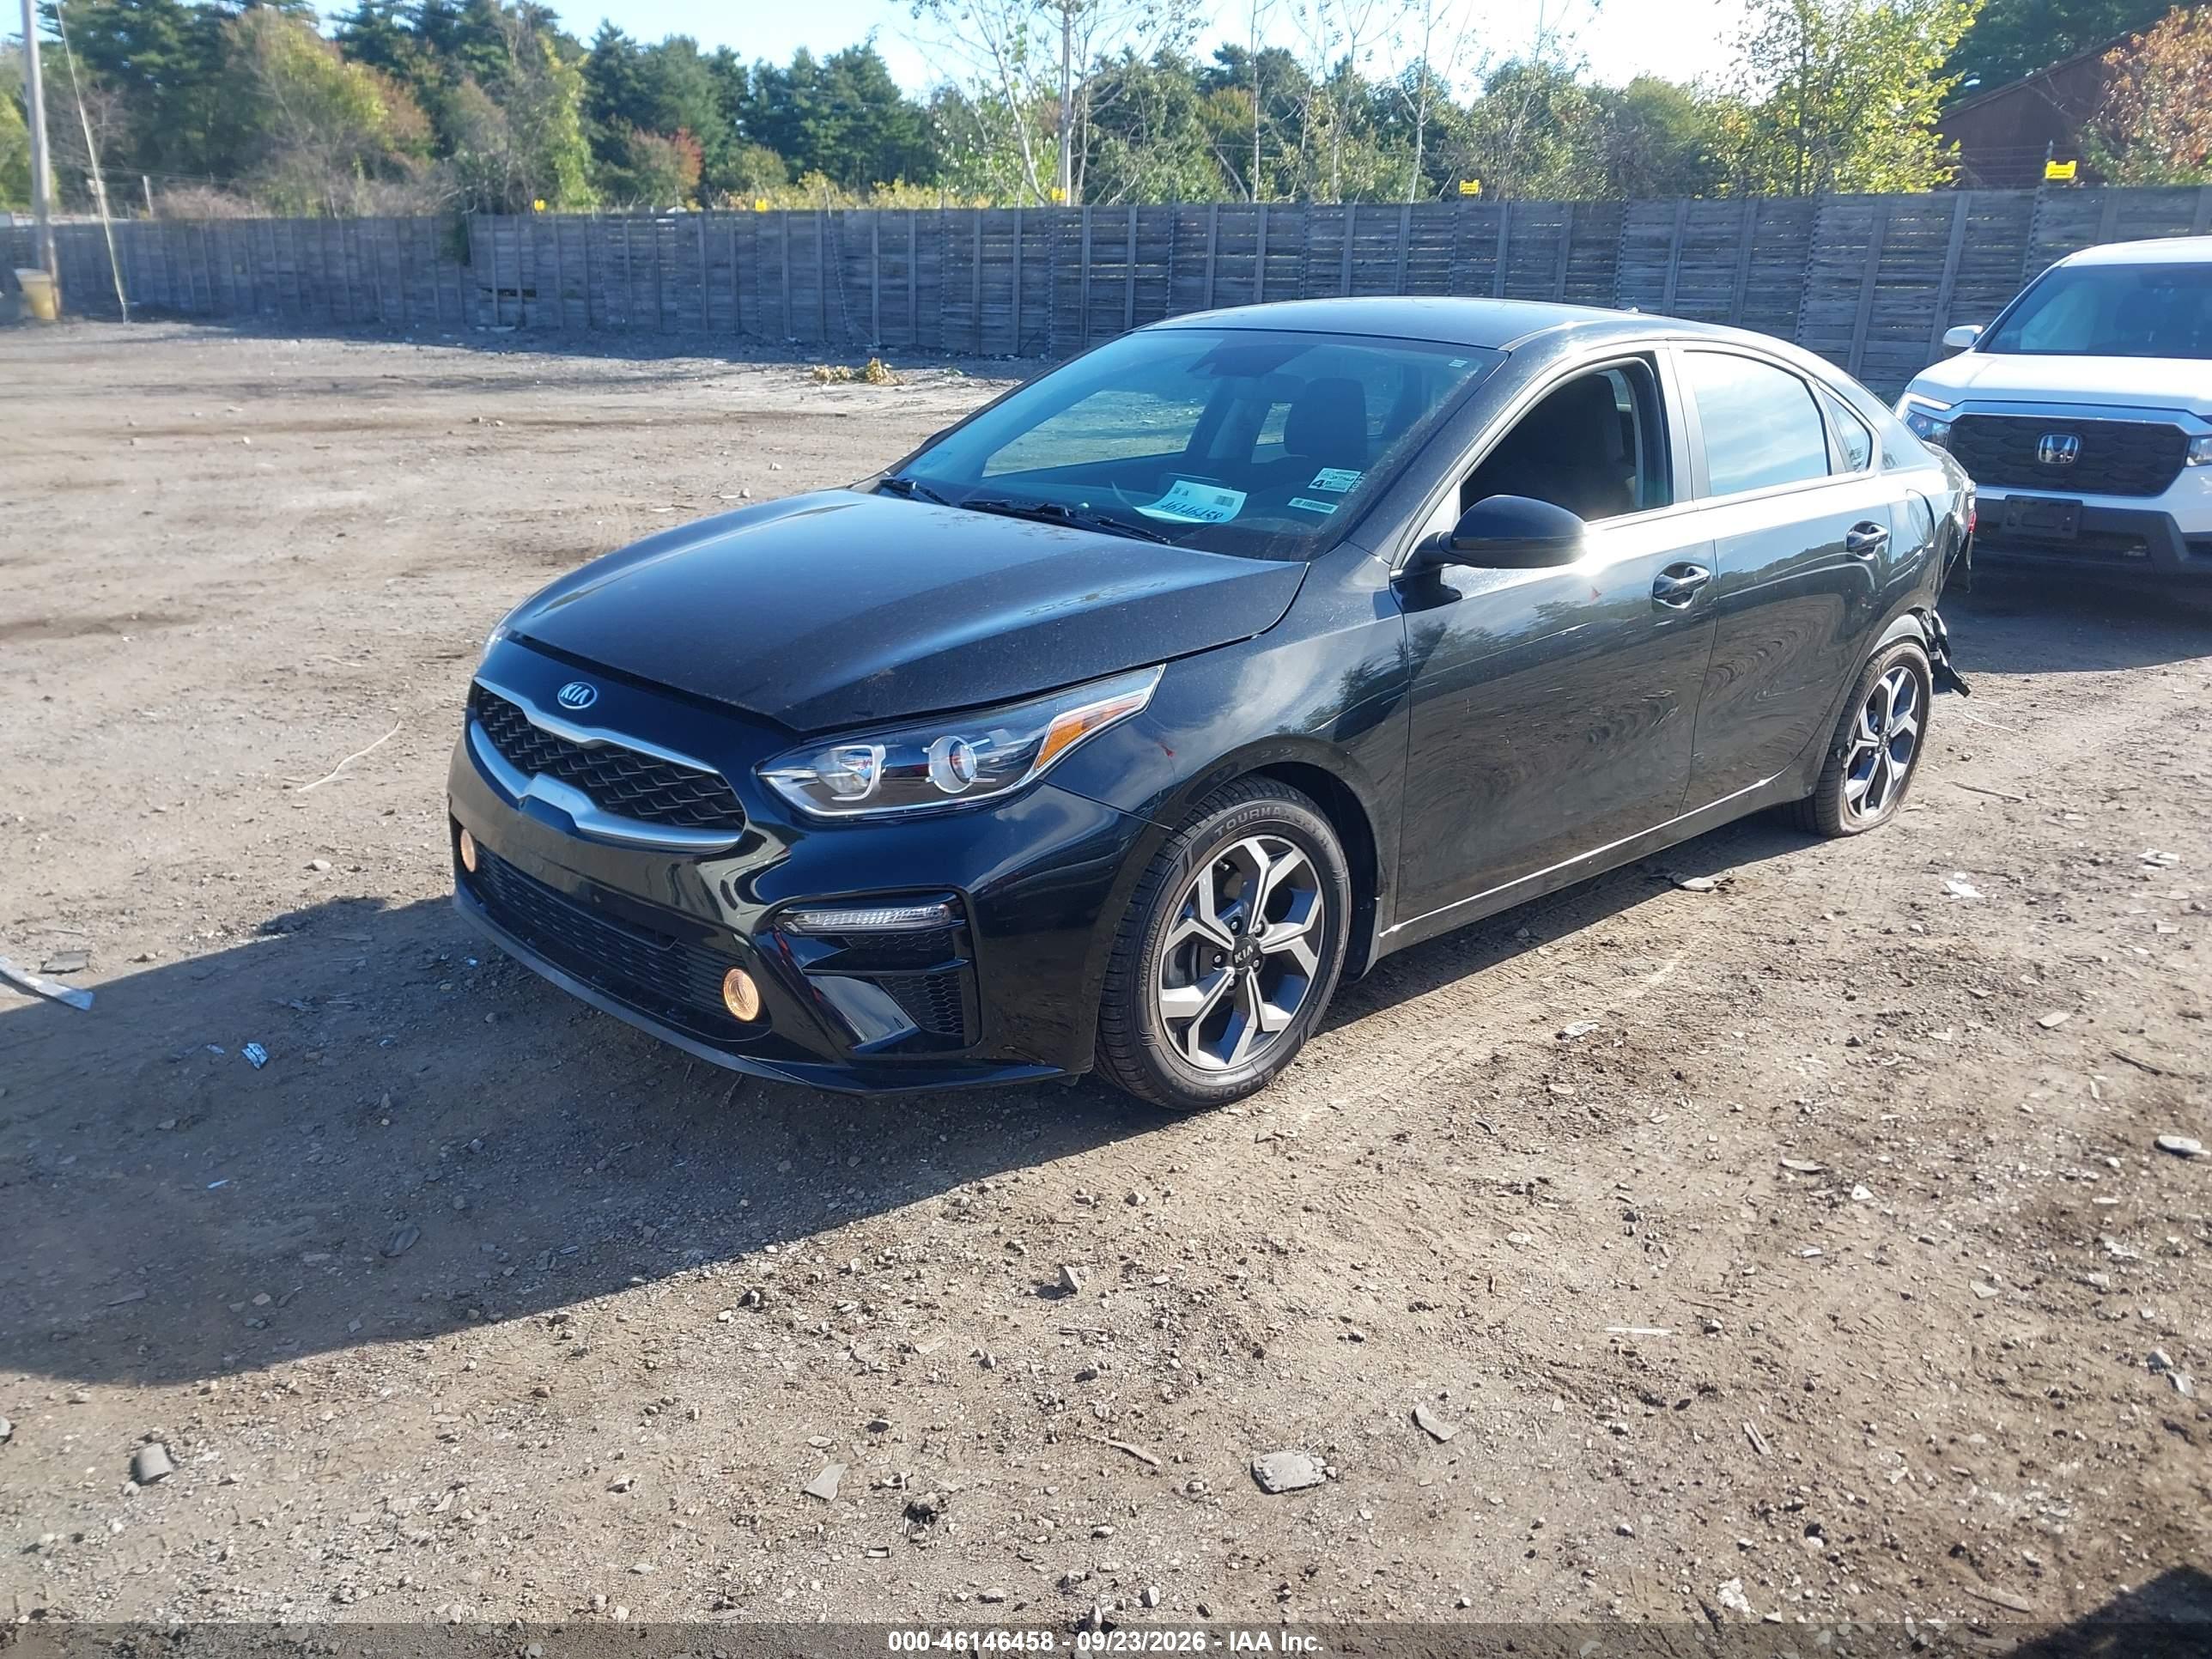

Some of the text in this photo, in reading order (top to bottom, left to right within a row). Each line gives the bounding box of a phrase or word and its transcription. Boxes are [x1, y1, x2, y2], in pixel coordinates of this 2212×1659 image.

[1311, 479, 1324, 489] 4
[560, 684, 590, 704] KIA
[1234, 945, 1253, 963] KIA
